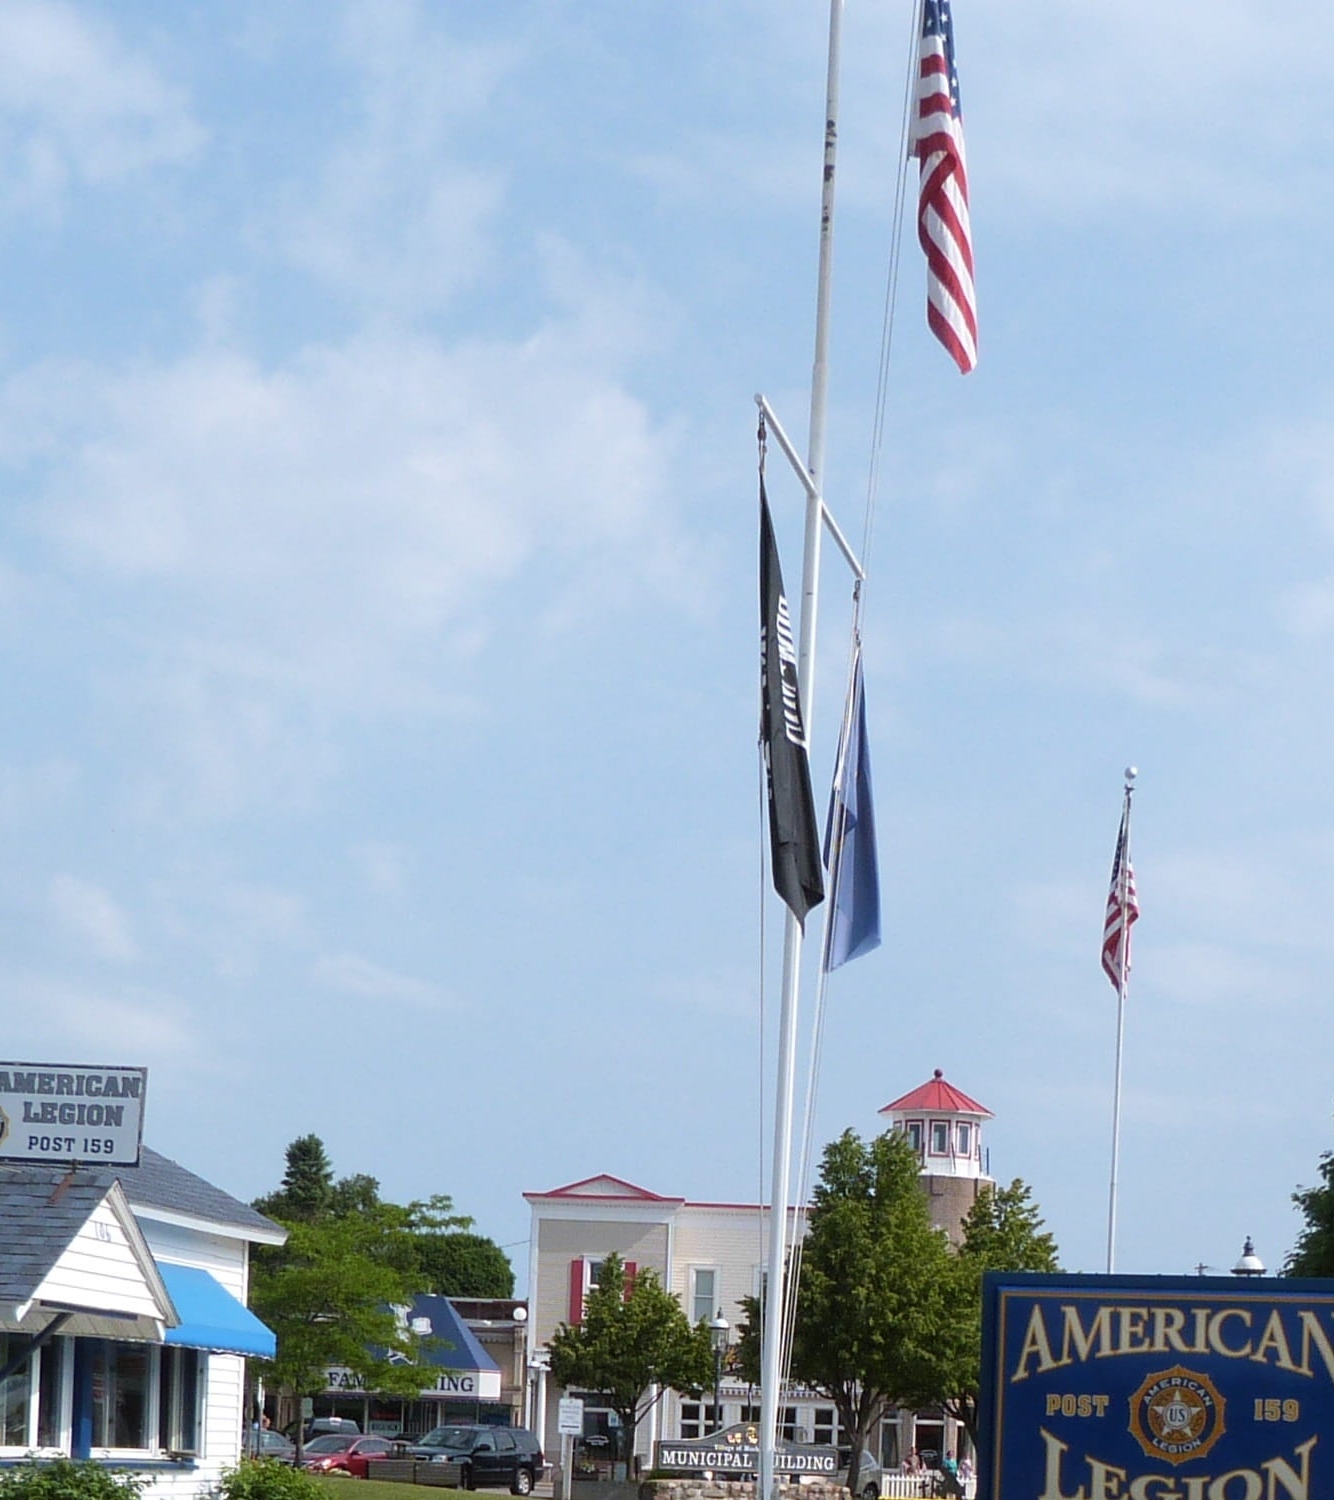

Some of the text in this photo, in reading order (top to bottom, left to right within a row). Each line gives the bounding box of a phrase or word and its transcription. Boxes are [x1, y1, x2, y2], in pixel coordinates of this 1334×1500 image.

[22, 1101, 125, 1127] LEGION
[28, 1135, 114, 1154] POST 159
[1143, 1378, 1213, 1407] AMERICAN
[1046, 1395, 1110, 1417] POST
[1169, 1408, 1186, 1422] US
[1254, 1398, 1300, 1422] 159
[1152, 1438, 1202, 1453] LEGION
[662, 1451, 753, 1468] MUNICIPAL
